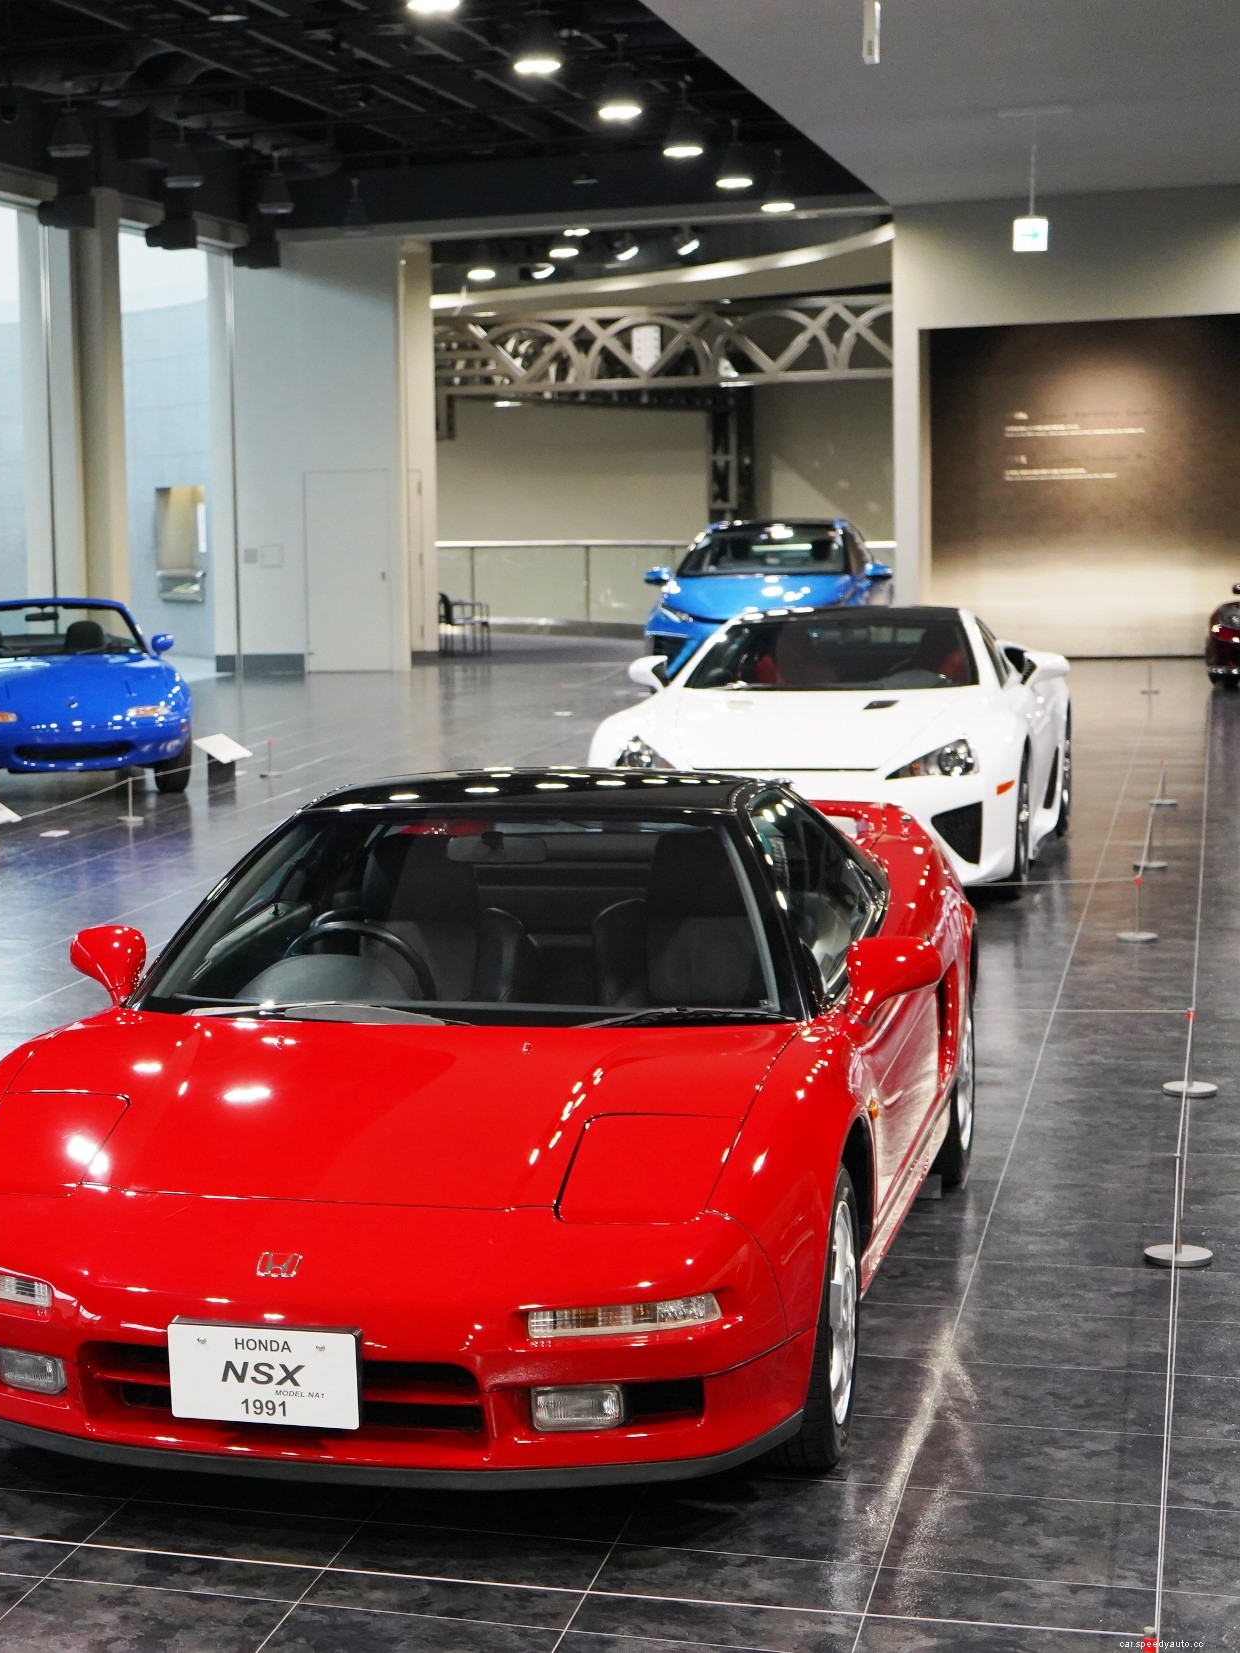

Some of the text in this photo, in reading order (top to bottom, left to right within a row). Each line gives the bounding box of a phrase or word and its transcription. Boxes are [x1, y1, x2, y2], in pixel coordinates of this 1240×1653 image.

[234, 1338, 292, 1353] HONDA
[221, 1360, 306, 1387] NSX
[274, 1389, 326, 1399] MODEL NA1
[241, 1398, 287, 1417] 1991
